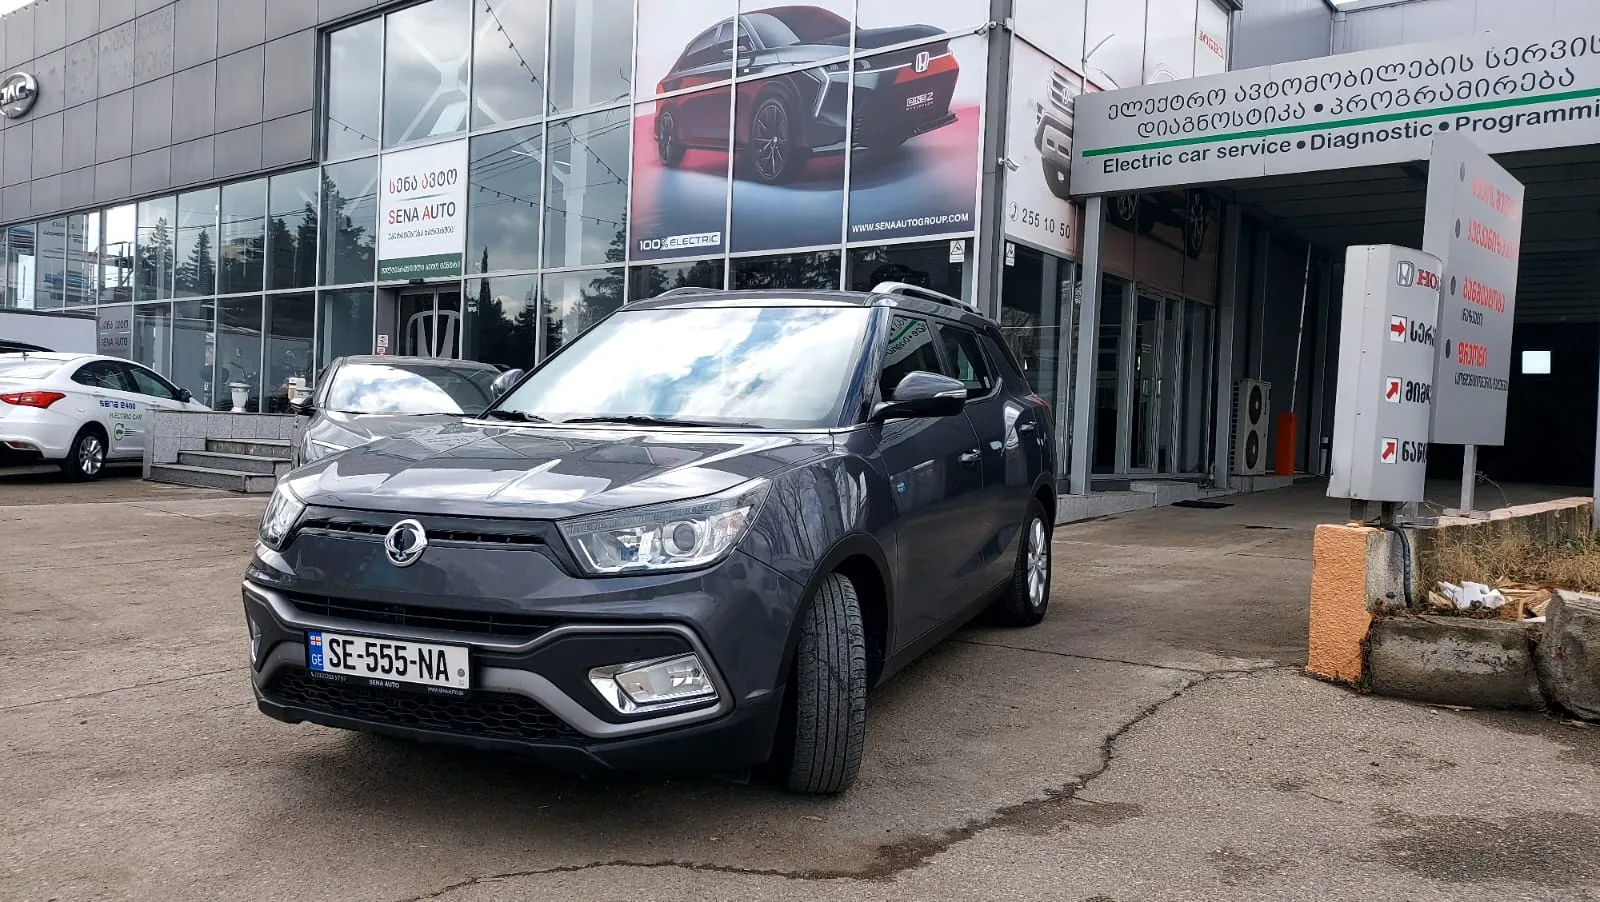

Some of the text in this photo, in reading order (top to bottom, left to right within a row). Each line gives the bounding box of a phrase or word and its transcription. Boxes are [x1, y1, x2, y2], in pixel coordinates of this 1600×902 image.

[1107, 87, 1226, 120] ელექტრო
[1234, 54, 1473, 103] ავტომობილების
[1137, 67, 1575, 138] დიაგნოსტიკა პროგრამირება
[1103, 151, 1173, 174] Electric
[1178, 147, 1211, 164] car
[1216, 137, 1292, 160] service
[1310, 120, 1434, 151] Diagnostic
[389, 168, 458, 194] სენა ავტო
[388, 201, 456, 225] SENA AUTO
[852, 212, 969, 233] WWW.SENAAUTOGROUP.COM
[1022, 208, 1071, 239] 255 10 50
[669, 234, 719, 247] ELECTRIC
[1416, 268, 1440, 292] HO
[311, 653, 323, 666] GE
[328, 637, 450, 682] SE-555-NA
[368, 679, 400, 689] SENA AUTO
